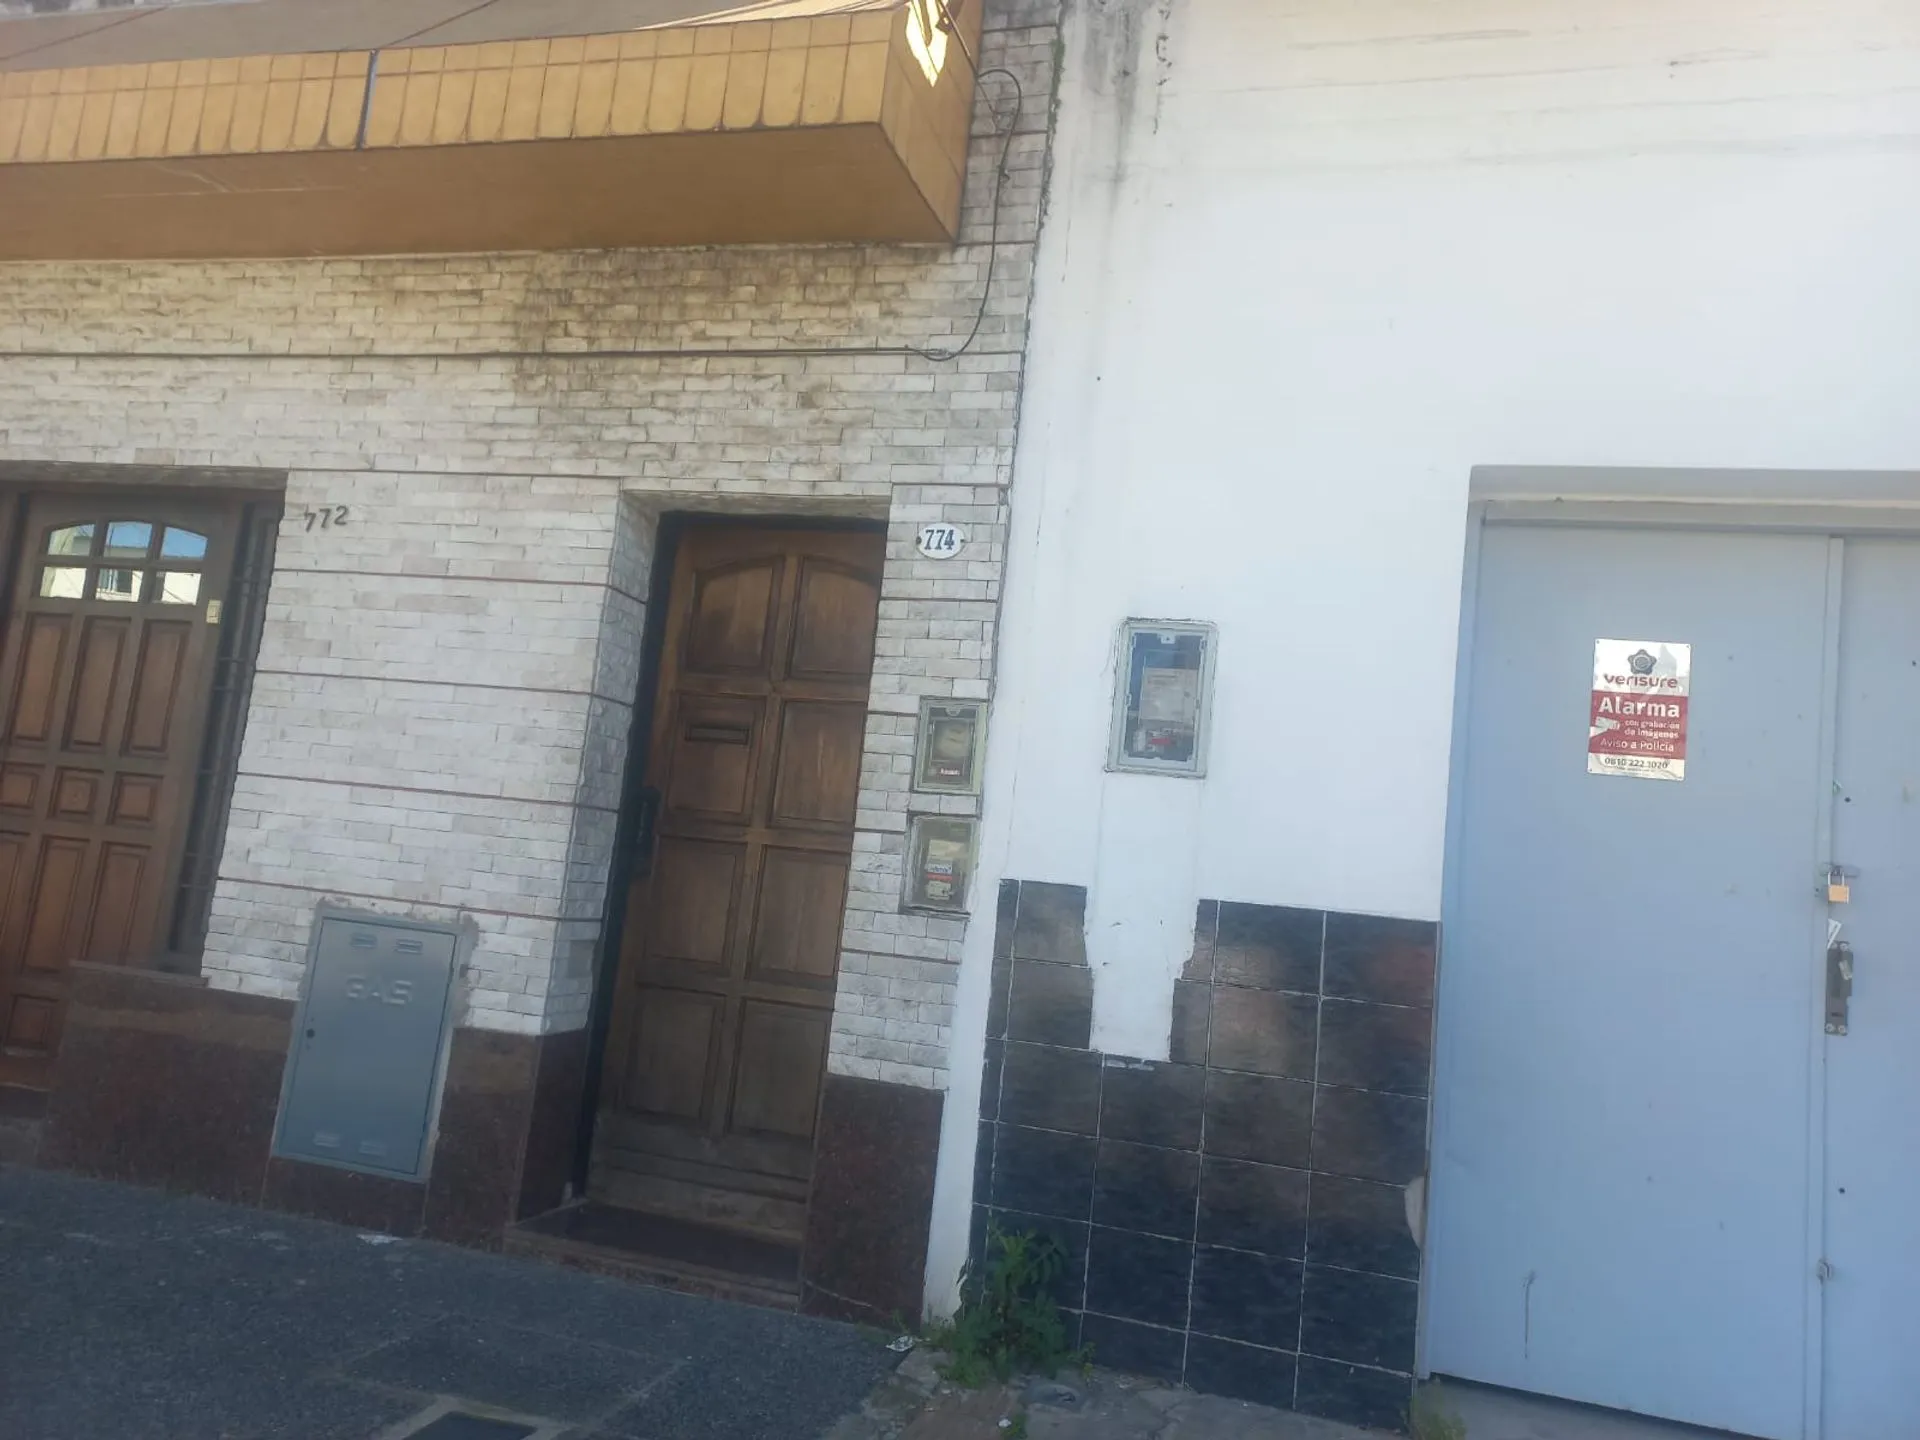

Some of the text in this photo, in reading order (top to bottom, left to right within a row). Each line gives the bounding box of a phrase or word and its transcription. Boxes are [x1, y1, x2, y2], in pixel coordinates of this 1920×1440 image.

[304, 503, 349, 533] 772
[924, 529, 955, 551] 774
[1603, 673, 1678, 689] verisure
[1598, 696, 1680, 718] Alarma
[1624, 728, 1636, 736] de
[1600, 738, 1628, 749] Aviso
